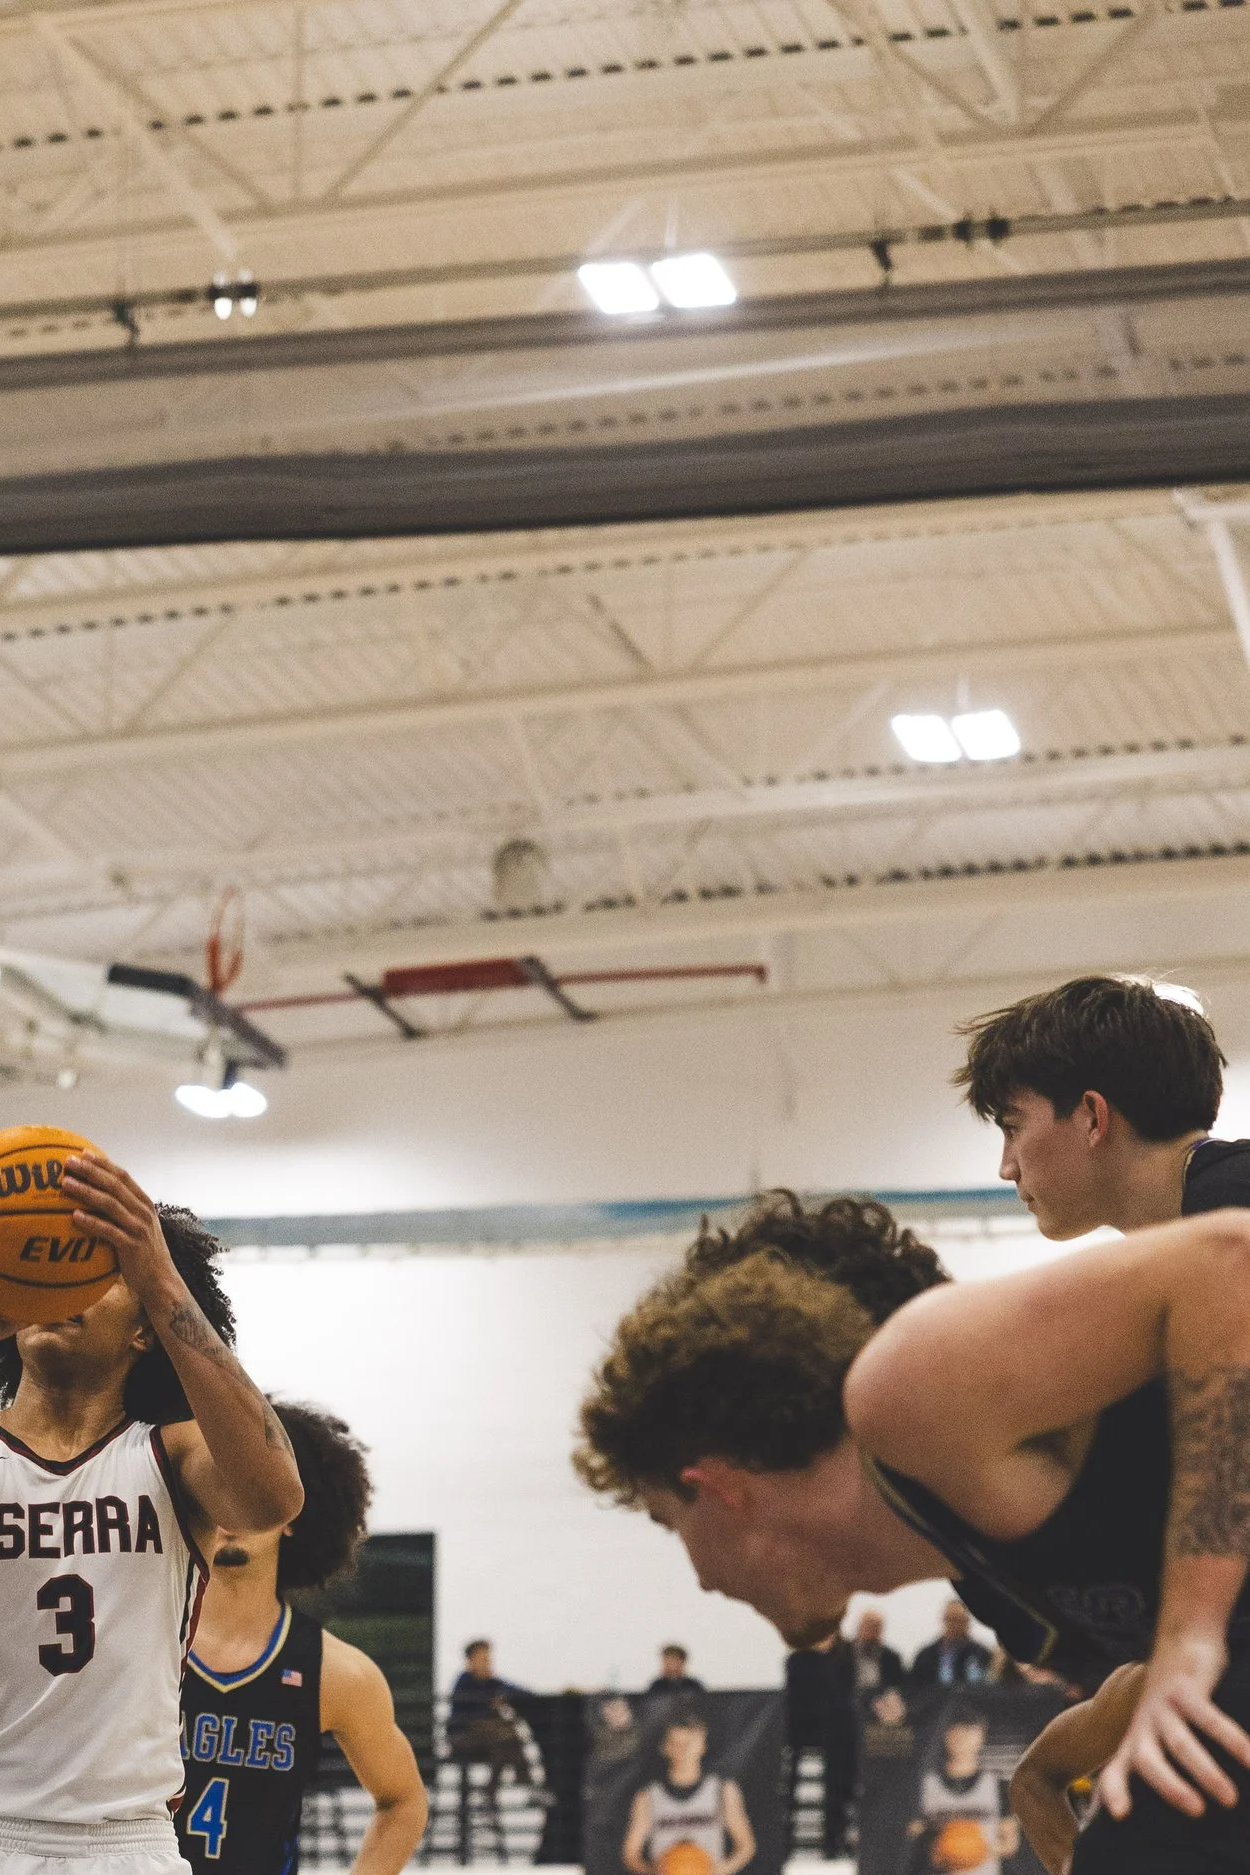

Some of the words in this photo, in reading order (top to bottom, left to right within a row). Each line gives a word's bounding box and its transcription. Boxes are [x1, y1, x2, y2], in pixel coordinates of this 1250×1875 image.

[19, 1235, 99, 1263] EVO
[36, 1573, 96, 1678] 3
[180, 1709, 296, 1771] GLES
[186, 1776, 230, 1860] 4
